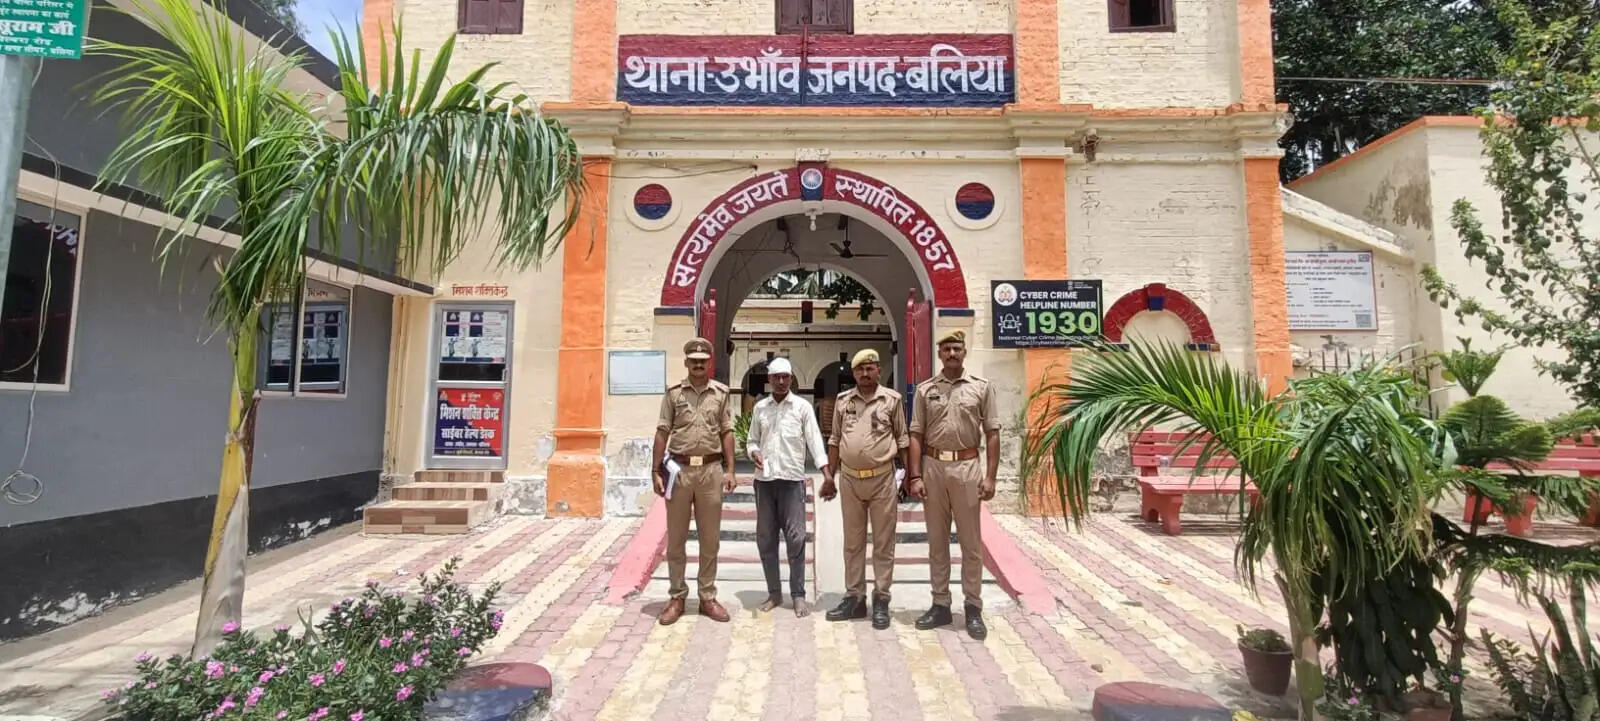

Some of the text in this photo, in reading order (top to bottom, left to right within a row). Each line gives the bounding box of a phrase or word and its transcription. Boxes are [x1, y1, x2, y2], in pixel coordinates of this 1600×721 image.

[48, 21, 77, 36] जी
[671, 171, 790, 287] सत्यमेव जयते
[1019, 291, 1078, 300] CYBER CRIME
[1020, 301, 1097, 310] HELPLINE NUMBER
[1025, 311, 1098, 334] 1930
[440, 403, 461, 420] मिशन
